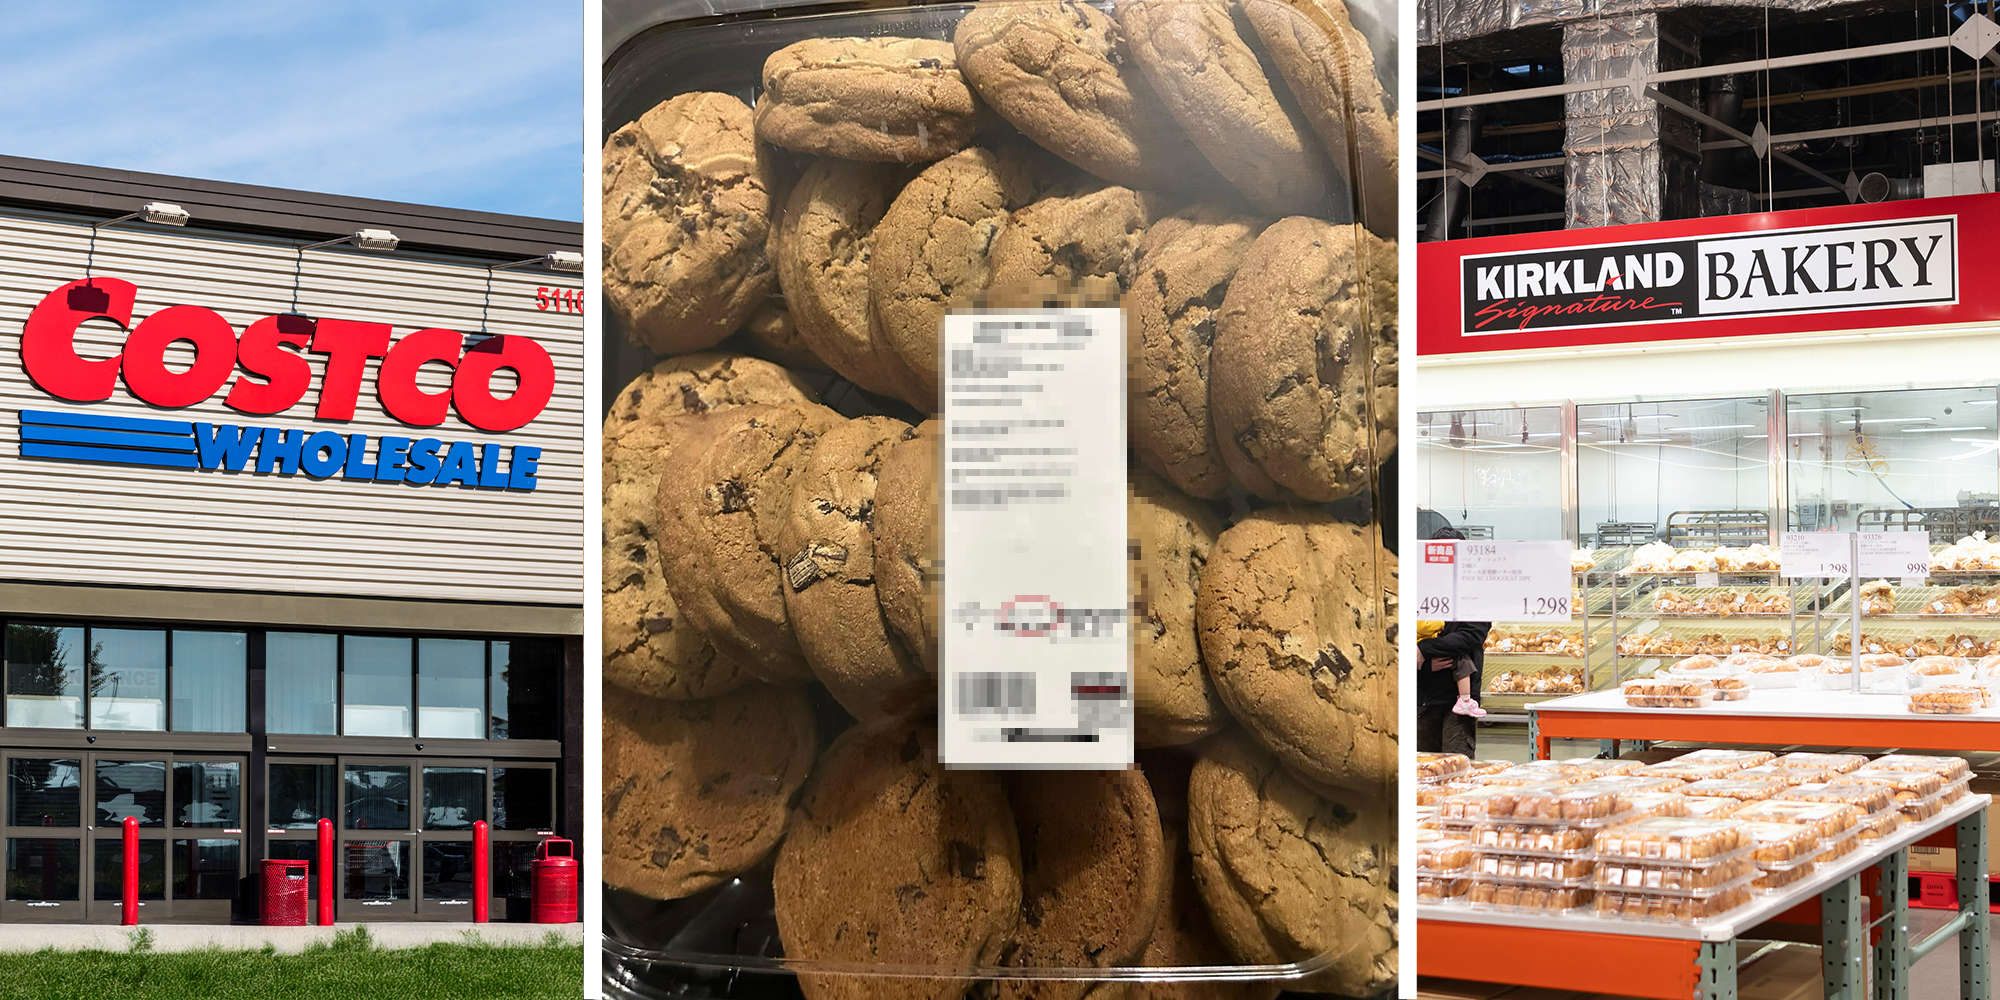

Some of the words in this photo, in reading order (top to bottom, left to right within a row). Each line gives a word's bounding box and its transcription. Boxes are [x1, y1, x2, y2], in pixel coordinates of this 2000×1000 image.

[1477, 251, 1684, 301] KIRKLAND
[1704, 234, 1943, 302] BAKERY
[1474, 294, 1683, 331] Signature
[21, 276, 556, 432] COSTCO
[194, 422, 543, 491] WHOLESALE
[1427, 545, 1454, 555] 新商品
[1467, 545, 1496, 556] 93184
[1907, 562, 1927, 574] 998
[1522, 596, 1568, 618] 1,298
